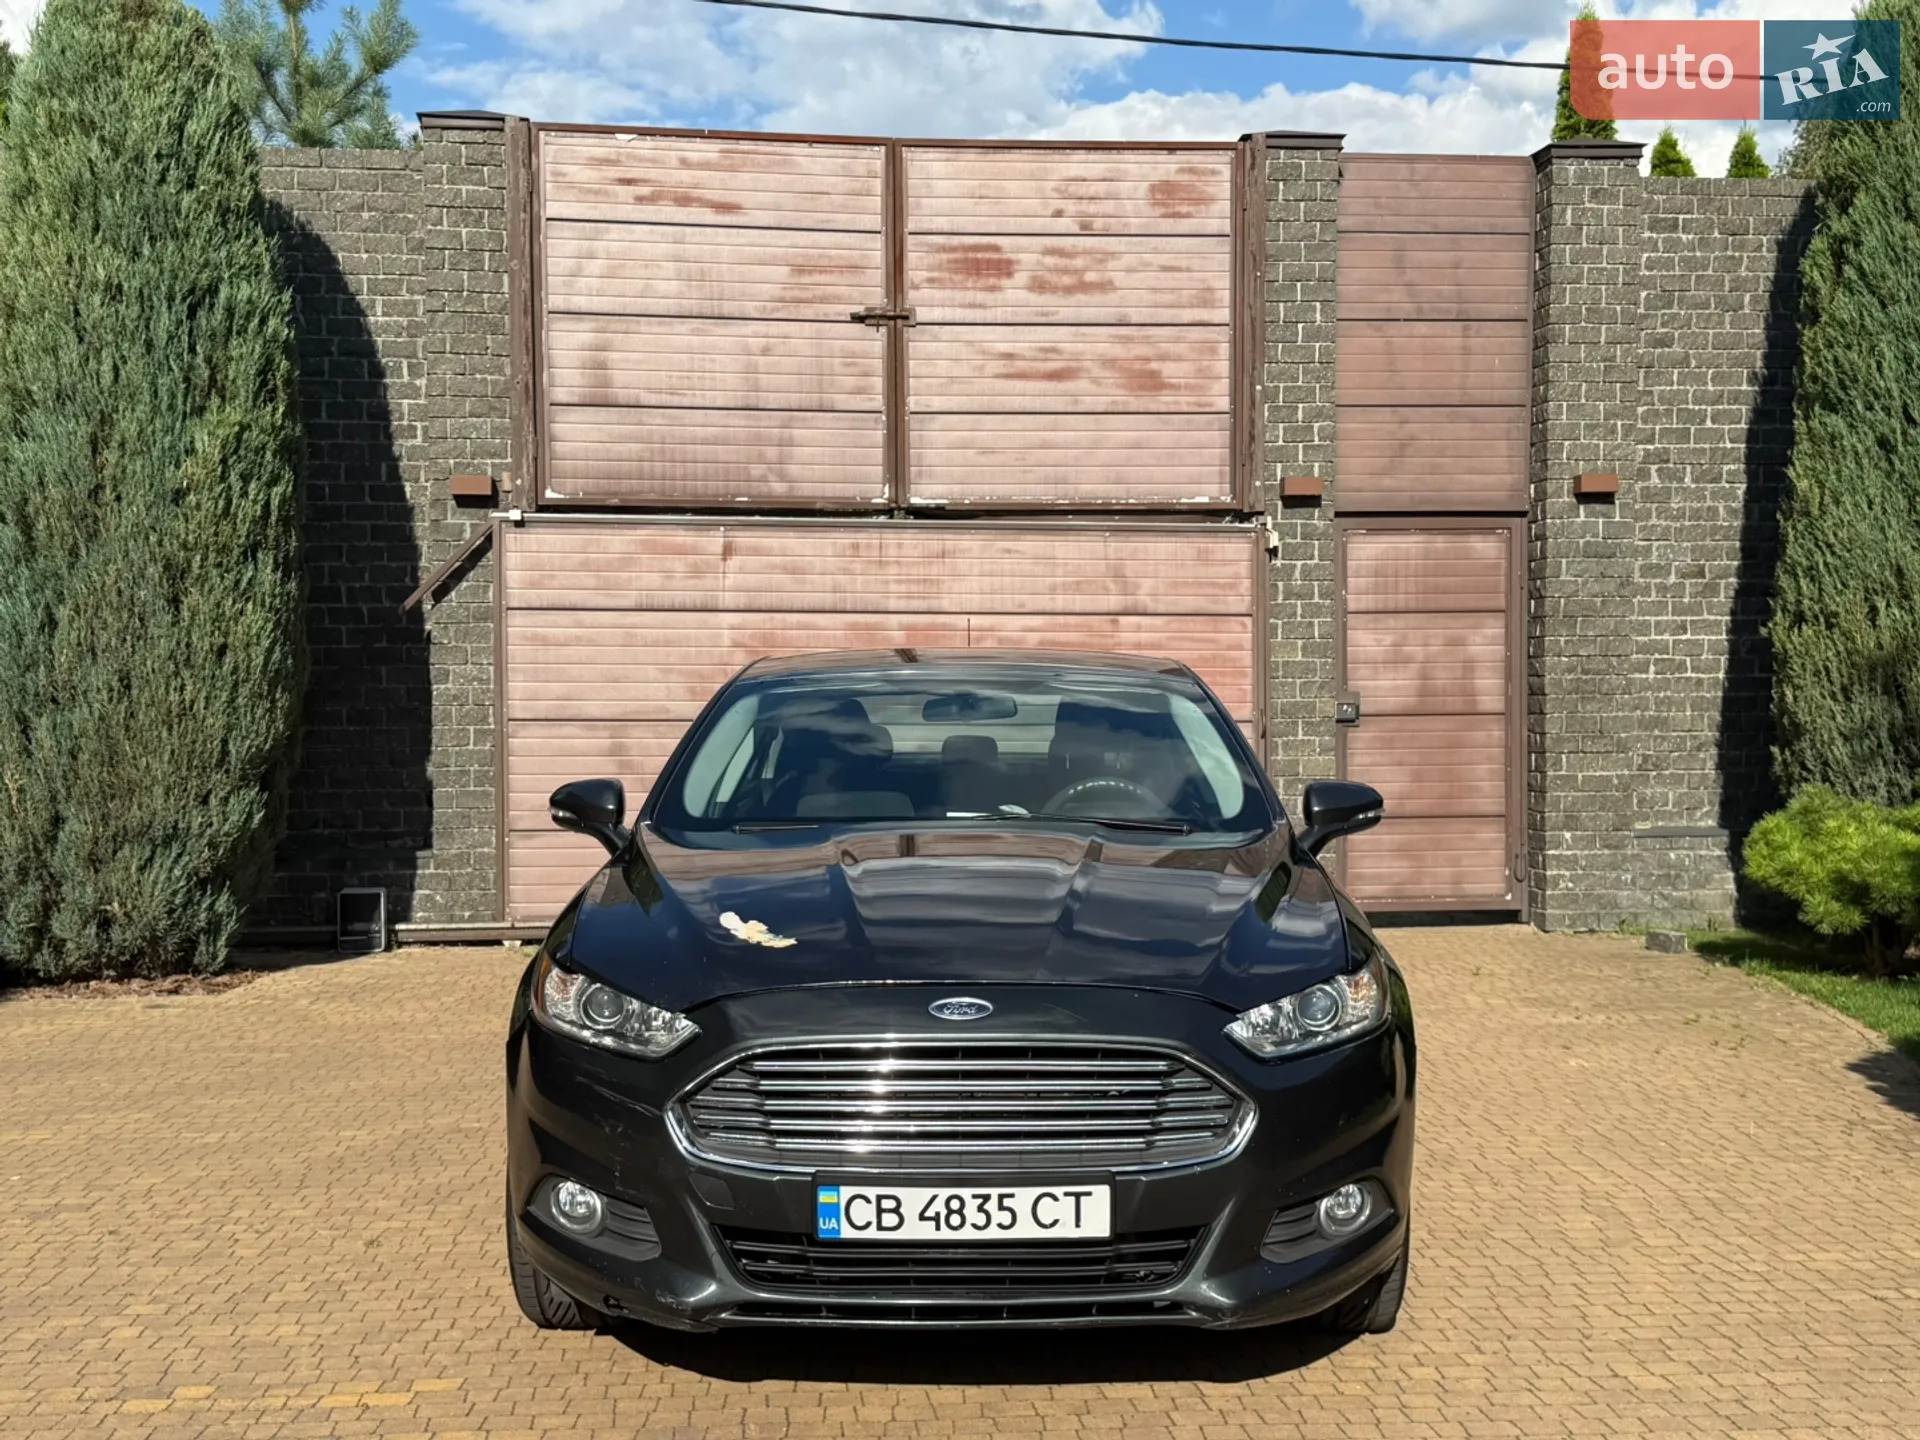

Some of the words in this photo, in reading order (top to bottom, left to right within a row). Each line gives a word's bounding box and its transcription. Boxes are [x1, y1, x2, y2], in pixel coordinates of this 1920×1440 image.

[943, 1003, 979, 1015] Ford
[844, 1193, 905, 1232] CB
[918, 1192, 1018, 1232] 4835
[1031, 1191, 1093, 1230] CT
[819, 1216, 839, 1230] UA
